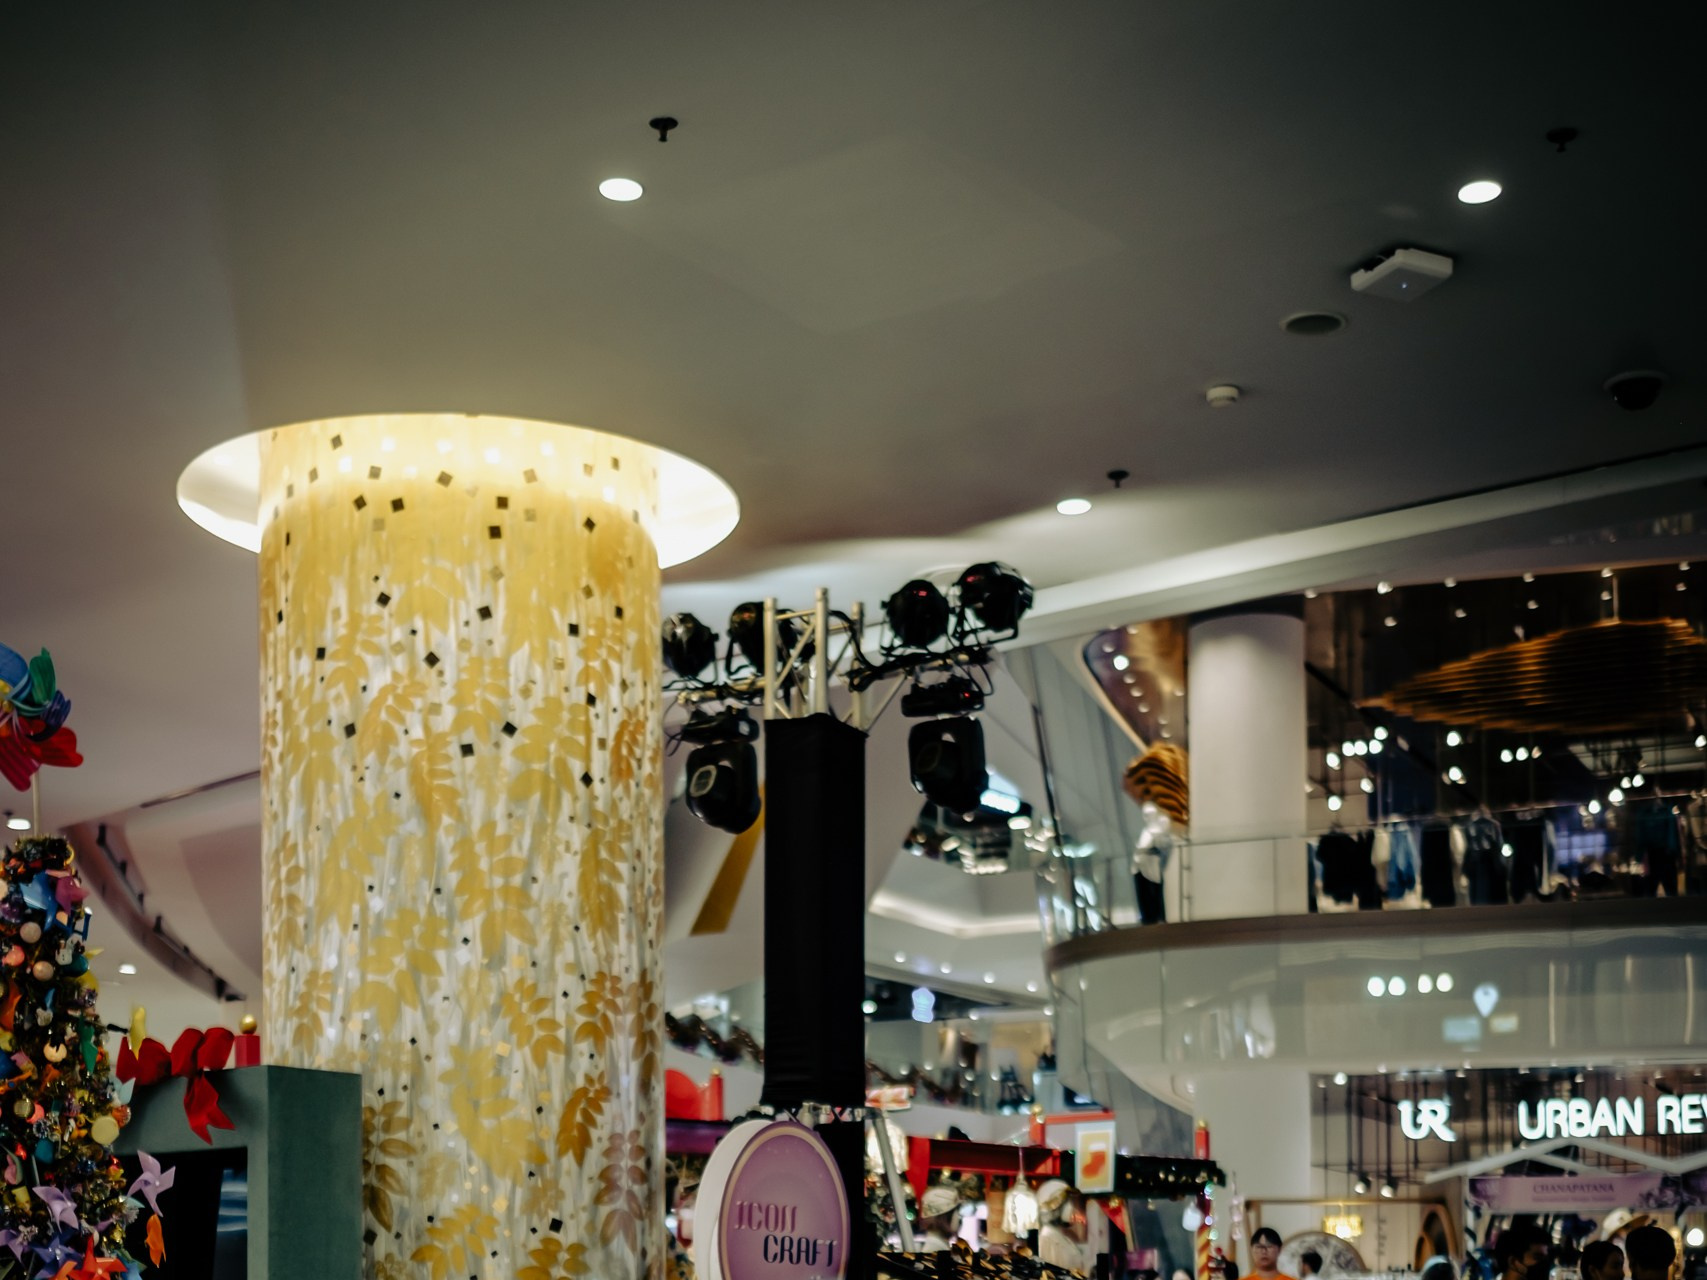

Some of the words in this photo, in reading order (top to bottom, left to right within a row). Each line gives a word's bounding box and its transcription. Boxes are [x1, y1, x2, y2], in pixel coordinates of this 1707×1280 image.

[1518, 1096, 1646, 1140] URBAN
[735, 1201, 797, 1233] ICON
[764, 1234, 838, 1267] CRAFT
